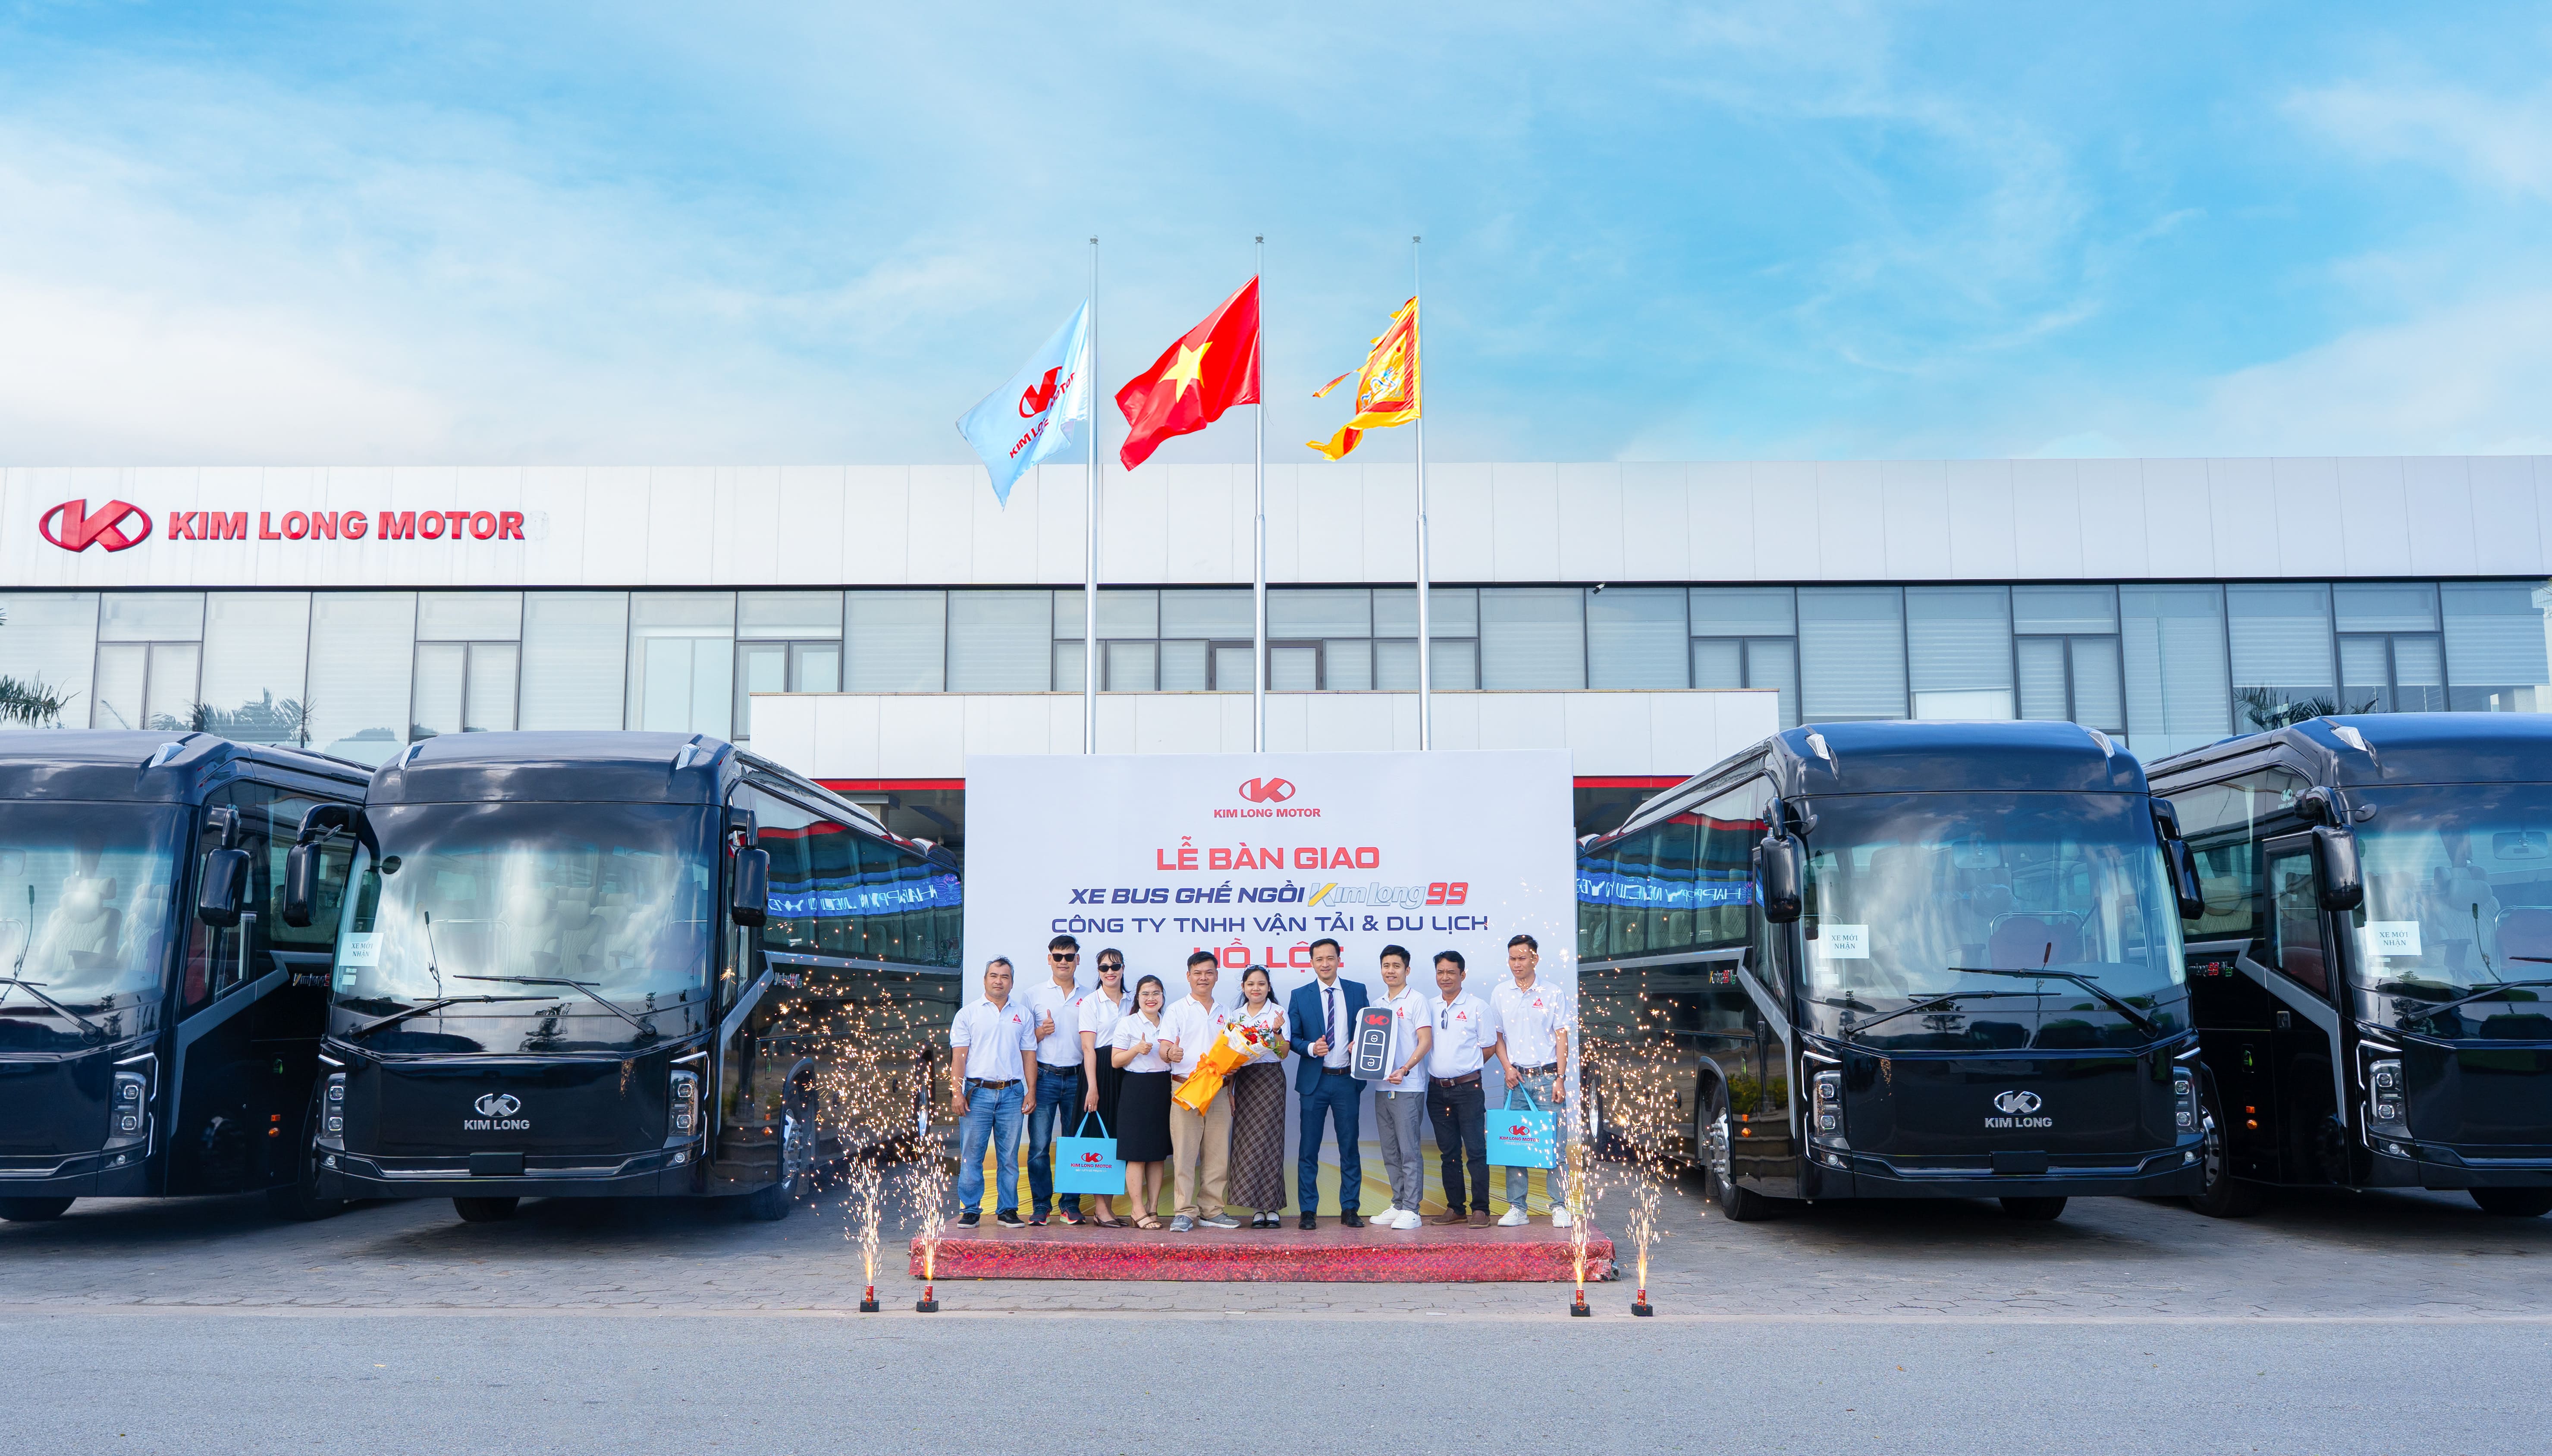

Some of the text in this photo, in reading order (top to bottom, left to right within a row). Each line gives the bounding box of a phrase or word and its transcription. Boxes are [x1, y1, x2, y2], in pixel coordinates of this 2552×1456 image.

[1009, 433, 1032, 458] KIM
[168, 511, 524, 540] KIM LONG MOTOR
[1214, 808, 1321, 818] KIM LONG MOTOR
[1157, 836, 1379, 870] LỄ BÀN GIAO
[1069, 888, 1106, 904] XE
[1111, 888, 1169, 904] BUS
[1176, 880, 1233, 904] GHẾ
[1238, 880, 1305, 903] NGỒI
[1052, 912, 1488, 935] CÔNG TY TNHH VẬN TẢI & DU LỊCH
[1835, 942, 1855, 950] NHẬN
[2384, 939, 2406, 947] NHẬN
[352, 950, 370, 958] NHẬN
[1266, 941, 1344, 973] LỘ
[464, 1120, 530, 1130] KIM LONG
[1985, 1117, 2053, 1128] KIM LONG
